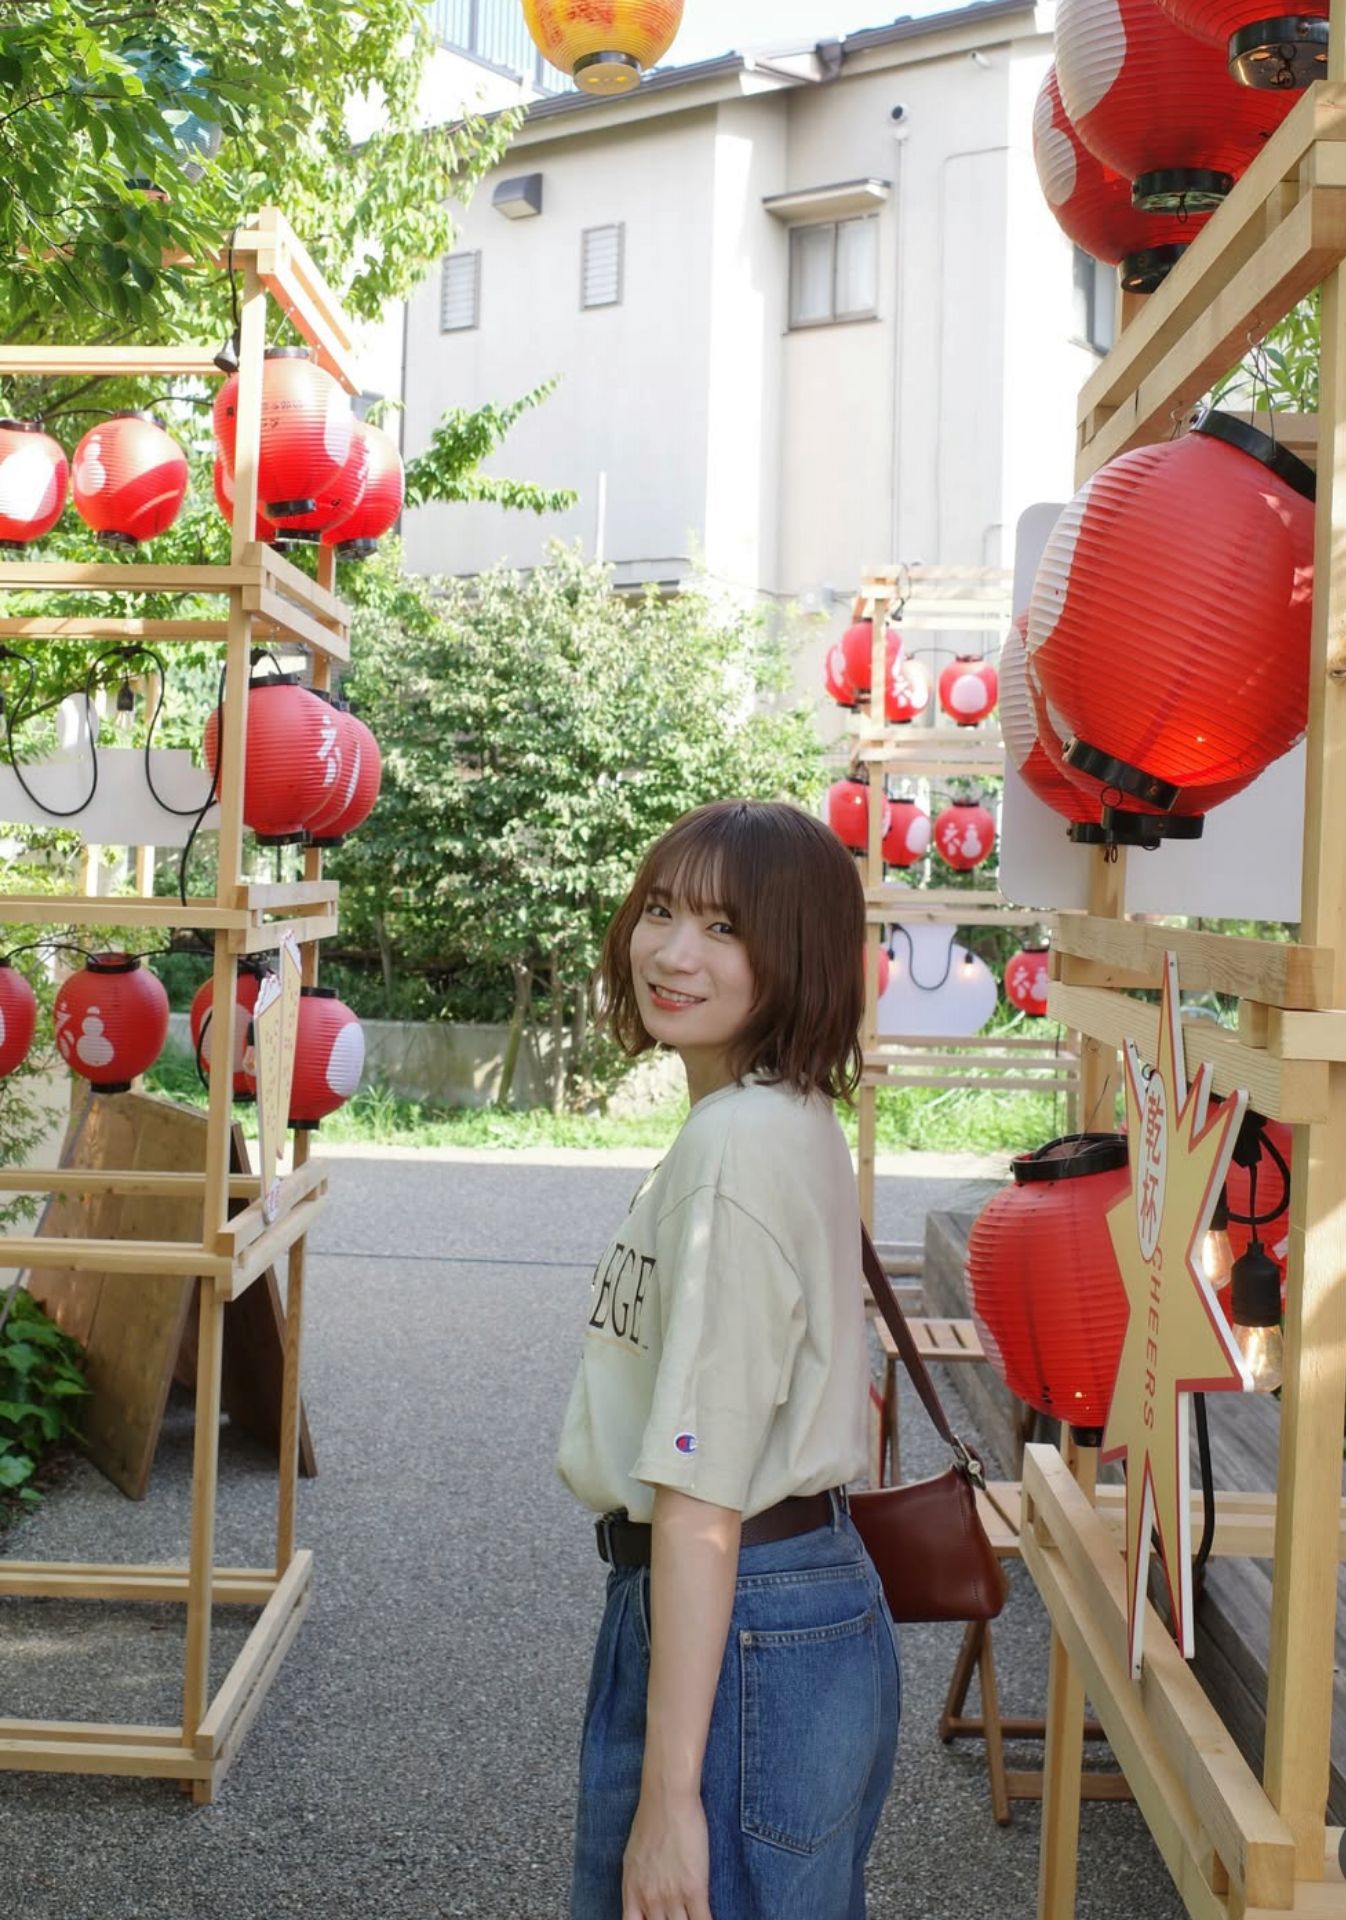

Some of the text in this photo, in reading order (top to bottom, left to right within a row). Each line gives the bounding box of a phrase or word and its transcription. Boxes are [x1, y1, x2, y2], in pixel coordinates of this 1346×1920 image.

[1140, 1090, 1164, 1243] 乾杯
[589, 1243, 656, 1345] EGE
[1143, 1246, 1163, 1431] CHEERS
